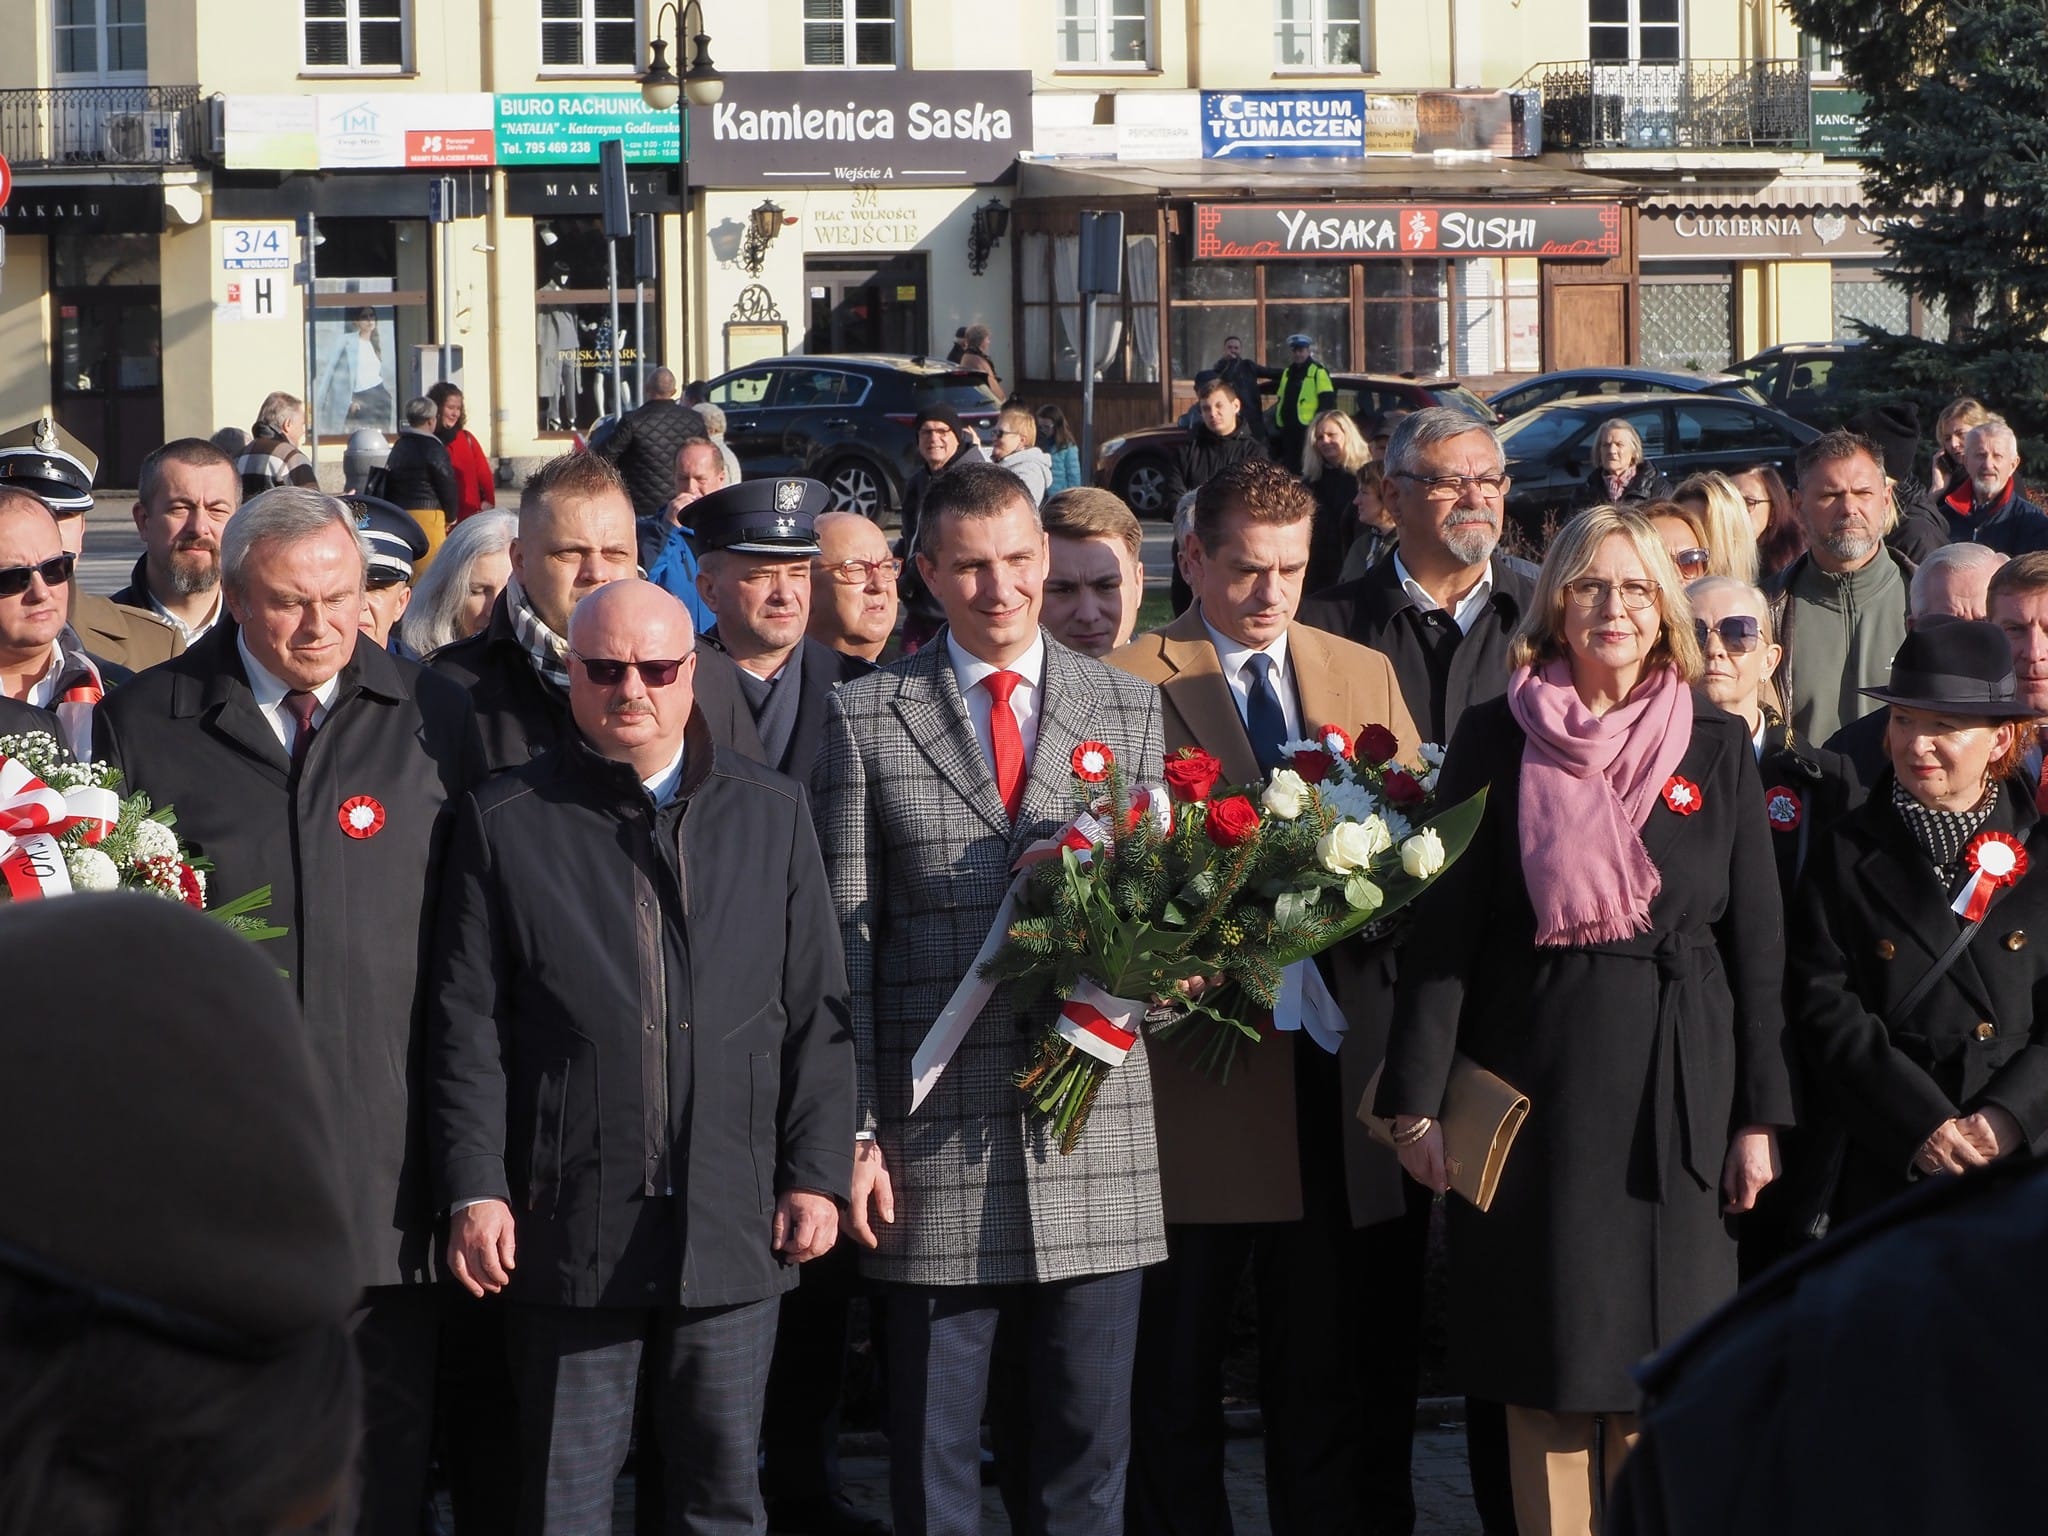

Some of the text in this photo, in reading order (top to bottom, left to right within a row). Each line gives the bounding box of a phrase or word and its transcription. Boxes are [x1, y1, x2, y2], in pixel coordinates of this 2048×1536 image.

[501, 98, 680, 115] BIURO RACHUNKOE
[1220, 95, 1352, 119] CENTRUM
[713, 102, 1012, 142] Kamienica Saska
[1208, 115, 1362, 138] TŁUMACZEŃ
[502, 142, 591, 154] Tel. 795 469 238
[834, 167, 893, 181] Wejście A
[546, 183, 656, 196] MAKLU
[815, 222, 918, 245] WEJŚCIE
[1277, 210, 1397, 250] YASAKA
[1441, 212, 1536, 249] SUSHI
[1675, 211, 1802, 237] CUKIERNIA
[235, 230, 279, 253] 3/4
[255, 278, 272, 314] H
[559, 349, 601, 361] POLSKA
